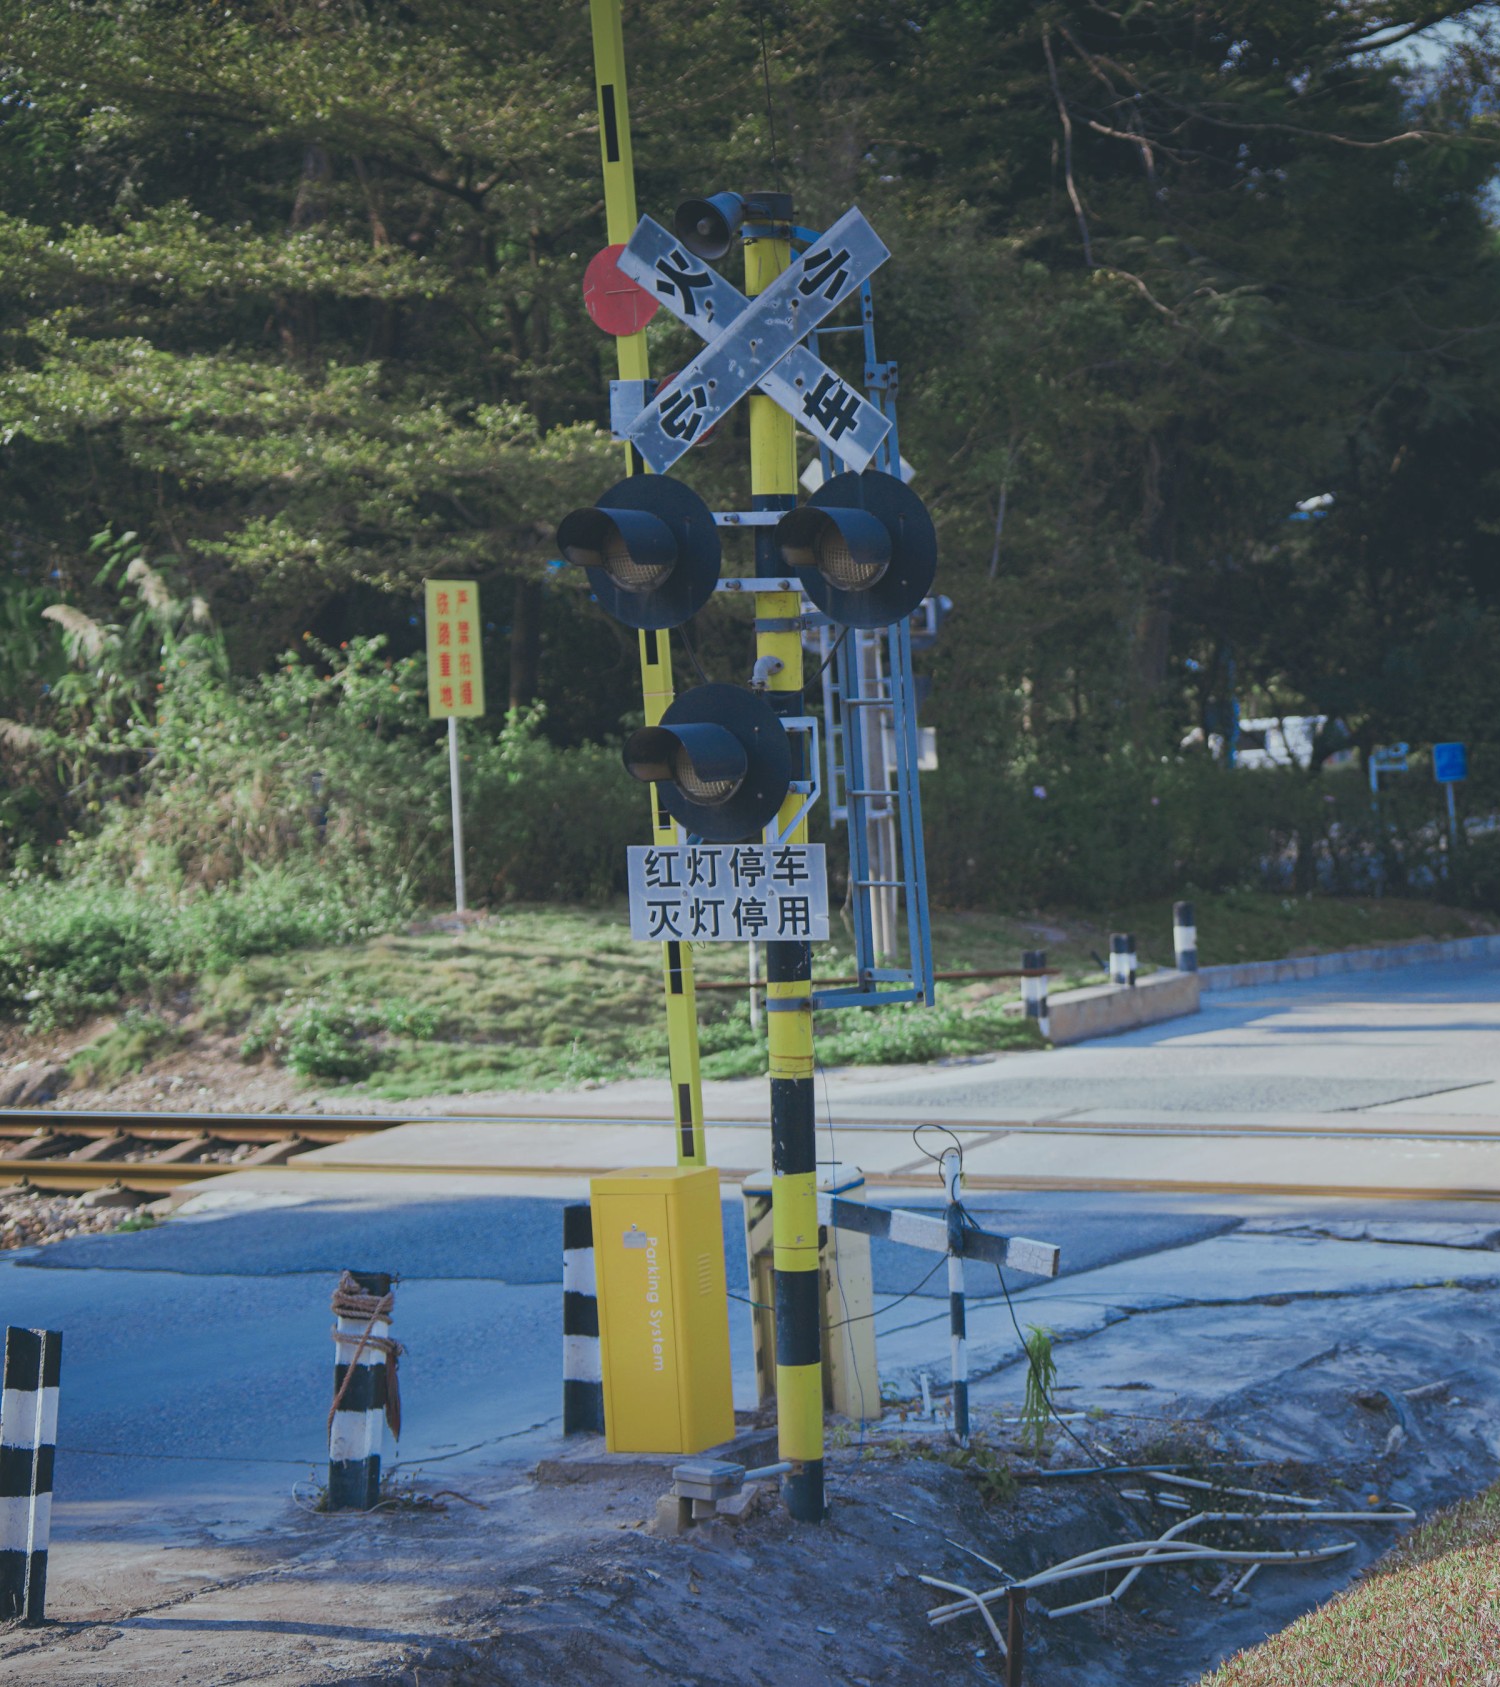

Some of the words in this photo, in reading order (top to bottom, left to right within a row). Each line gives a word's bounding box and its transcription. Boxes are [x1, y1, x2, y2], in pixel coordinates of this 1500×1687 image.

[644, 846, 809, 888] 红灯停车
[646, 896, 810, 938] 灭灯停用
[646, 1237, 661, 1303] Parking
[648, 1309, 665, 1371] System
